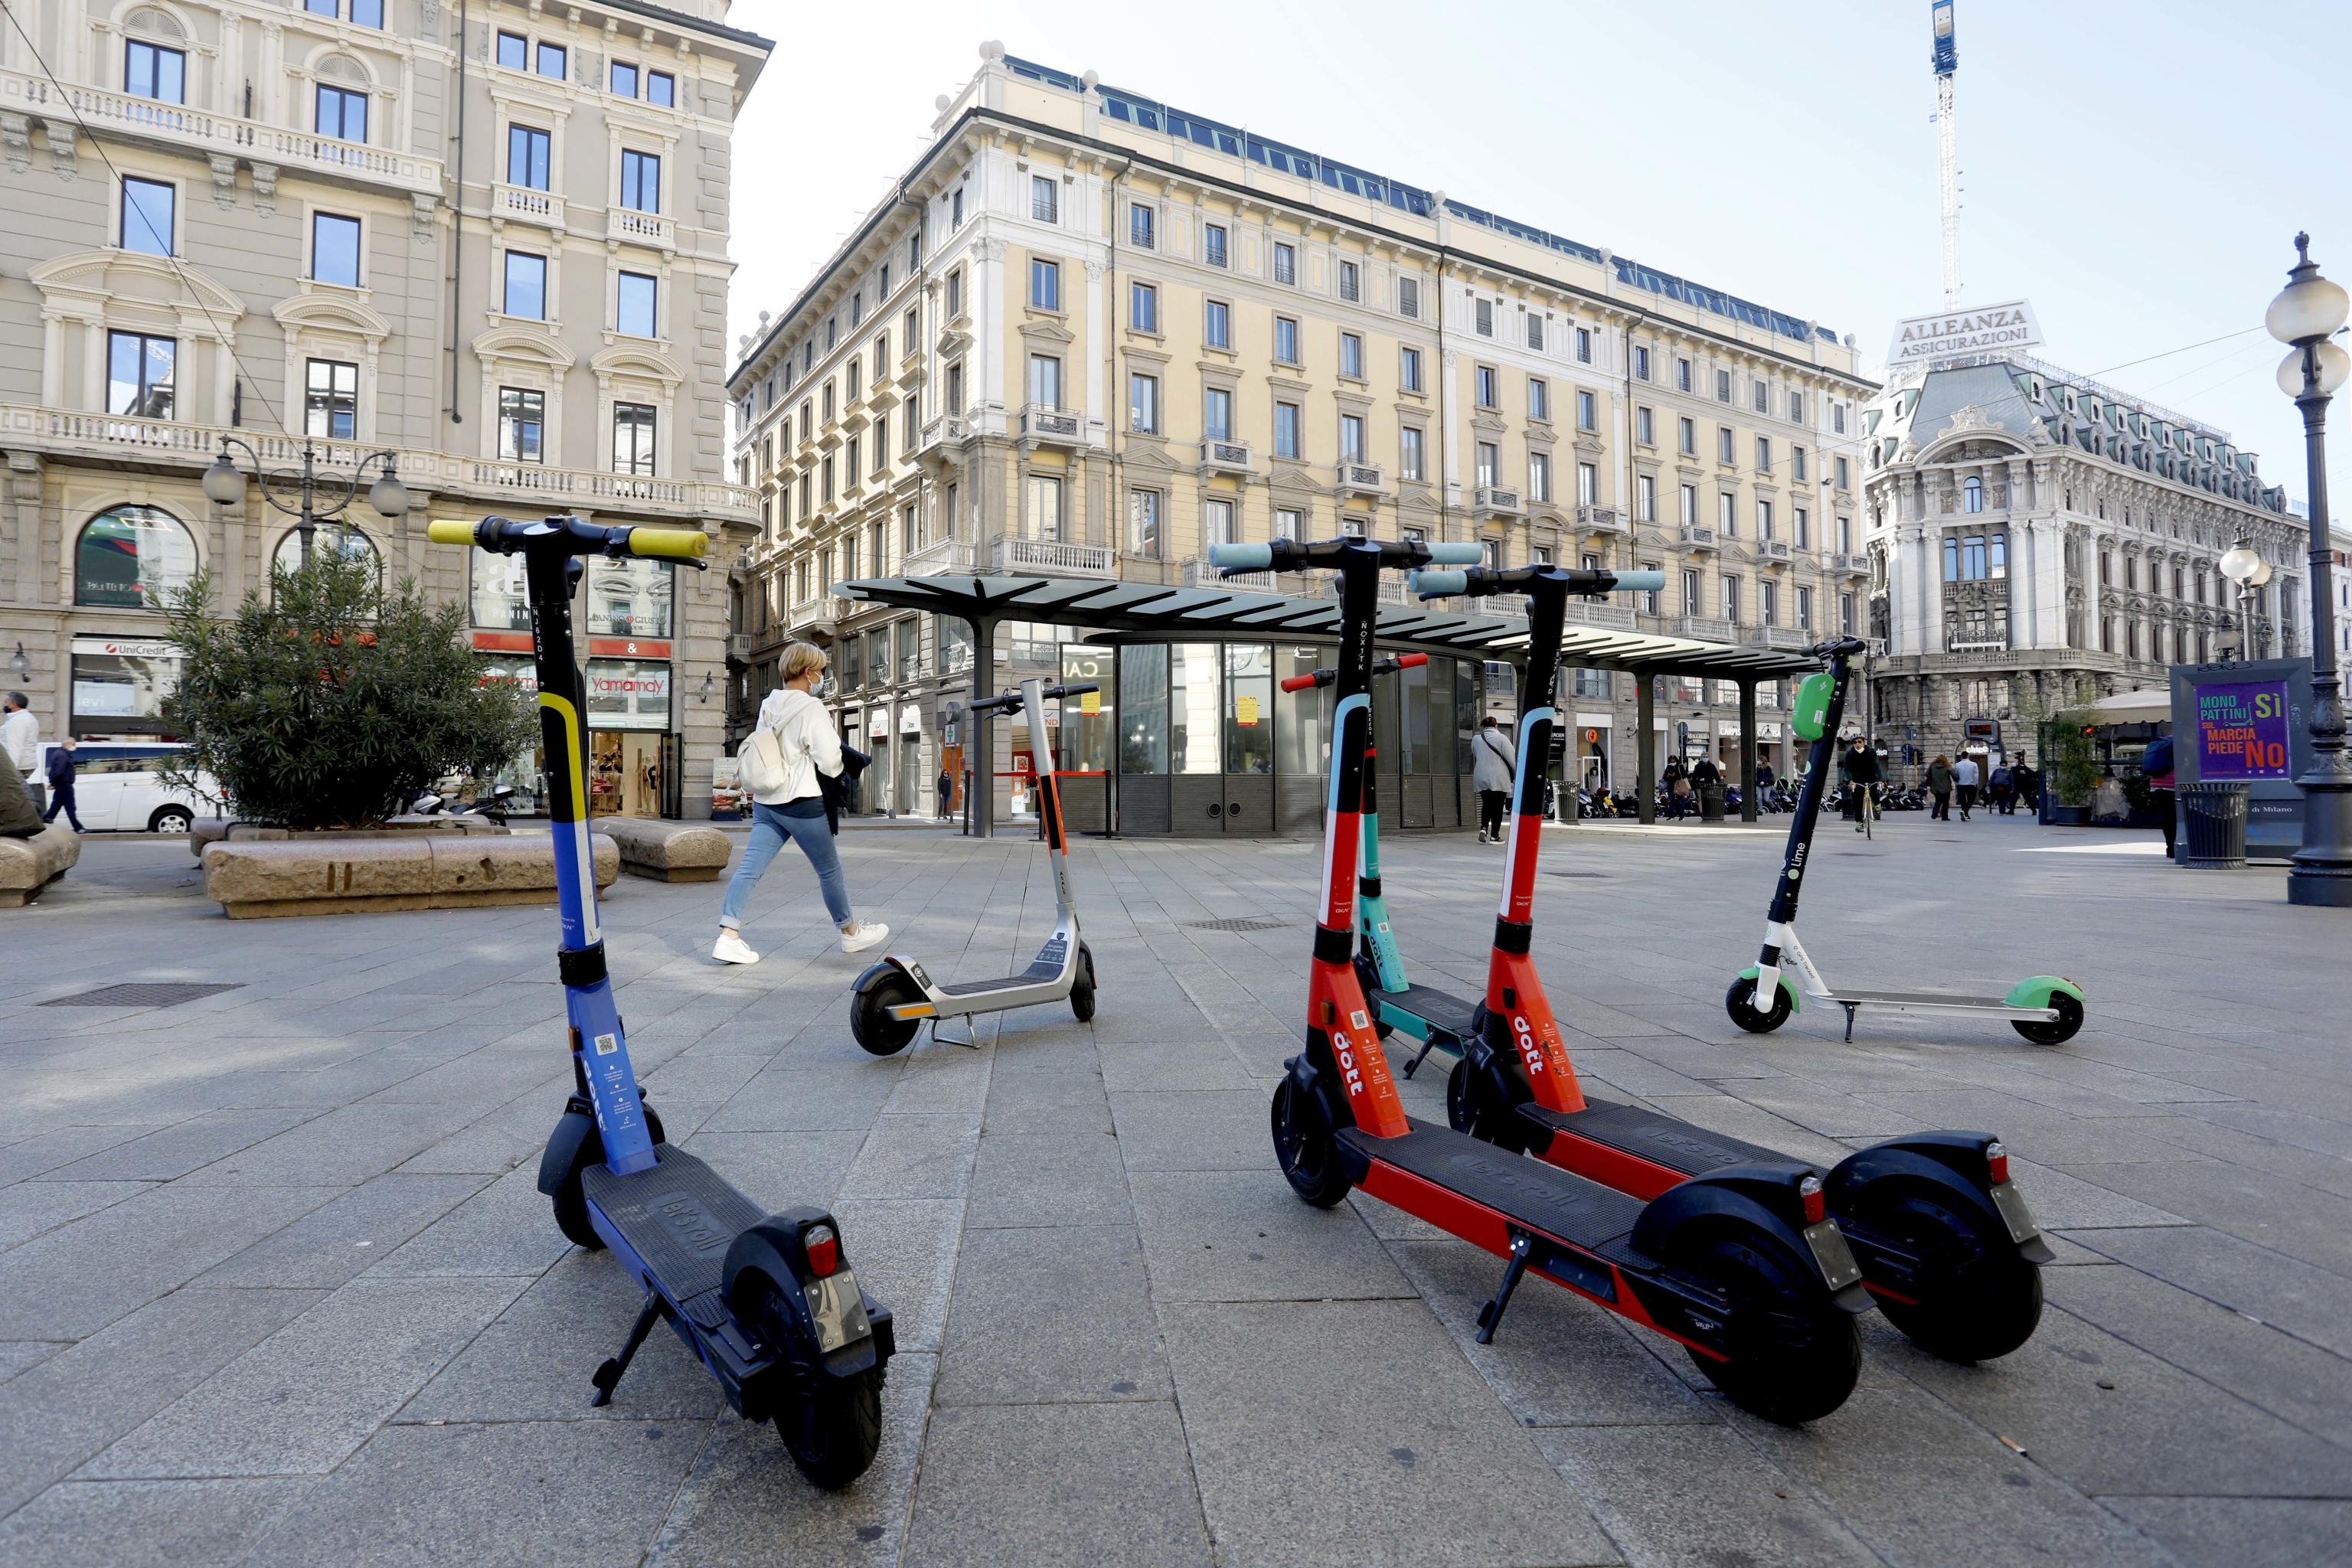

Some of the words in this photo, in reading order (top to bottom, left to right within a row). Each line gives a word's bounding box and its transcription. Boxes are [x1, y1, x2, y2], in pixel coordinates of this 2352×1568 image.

[1900, 309, 2027, 342] ALLEANZA
[1900, 327, 2028, 358] ASSICURAZIONI
[492, 609, 529, 620] PANIN
[635, 616, 666, 625] GIUSTO
[119, 645, 167, 655] UniCredit
[627, 642, 637, 654] &
[591, 676, 665, 694] Yamamay
[2200, 695, 2236, 709] MONO
[2200, 707, 2246, 720] PATTINI
[1720, 727, 1741, 737] CARPIS
[2207, 727, 2256, 741] MARCIA
[2208, 741, 2244, 754] PIEDE
[1791, 842, 1806, 867] Lime
[1370, 936, 1383, 972] dott
[1514, 1016, 1544, 1075] dott
[1334, 1031, 1363, 1096] dott
